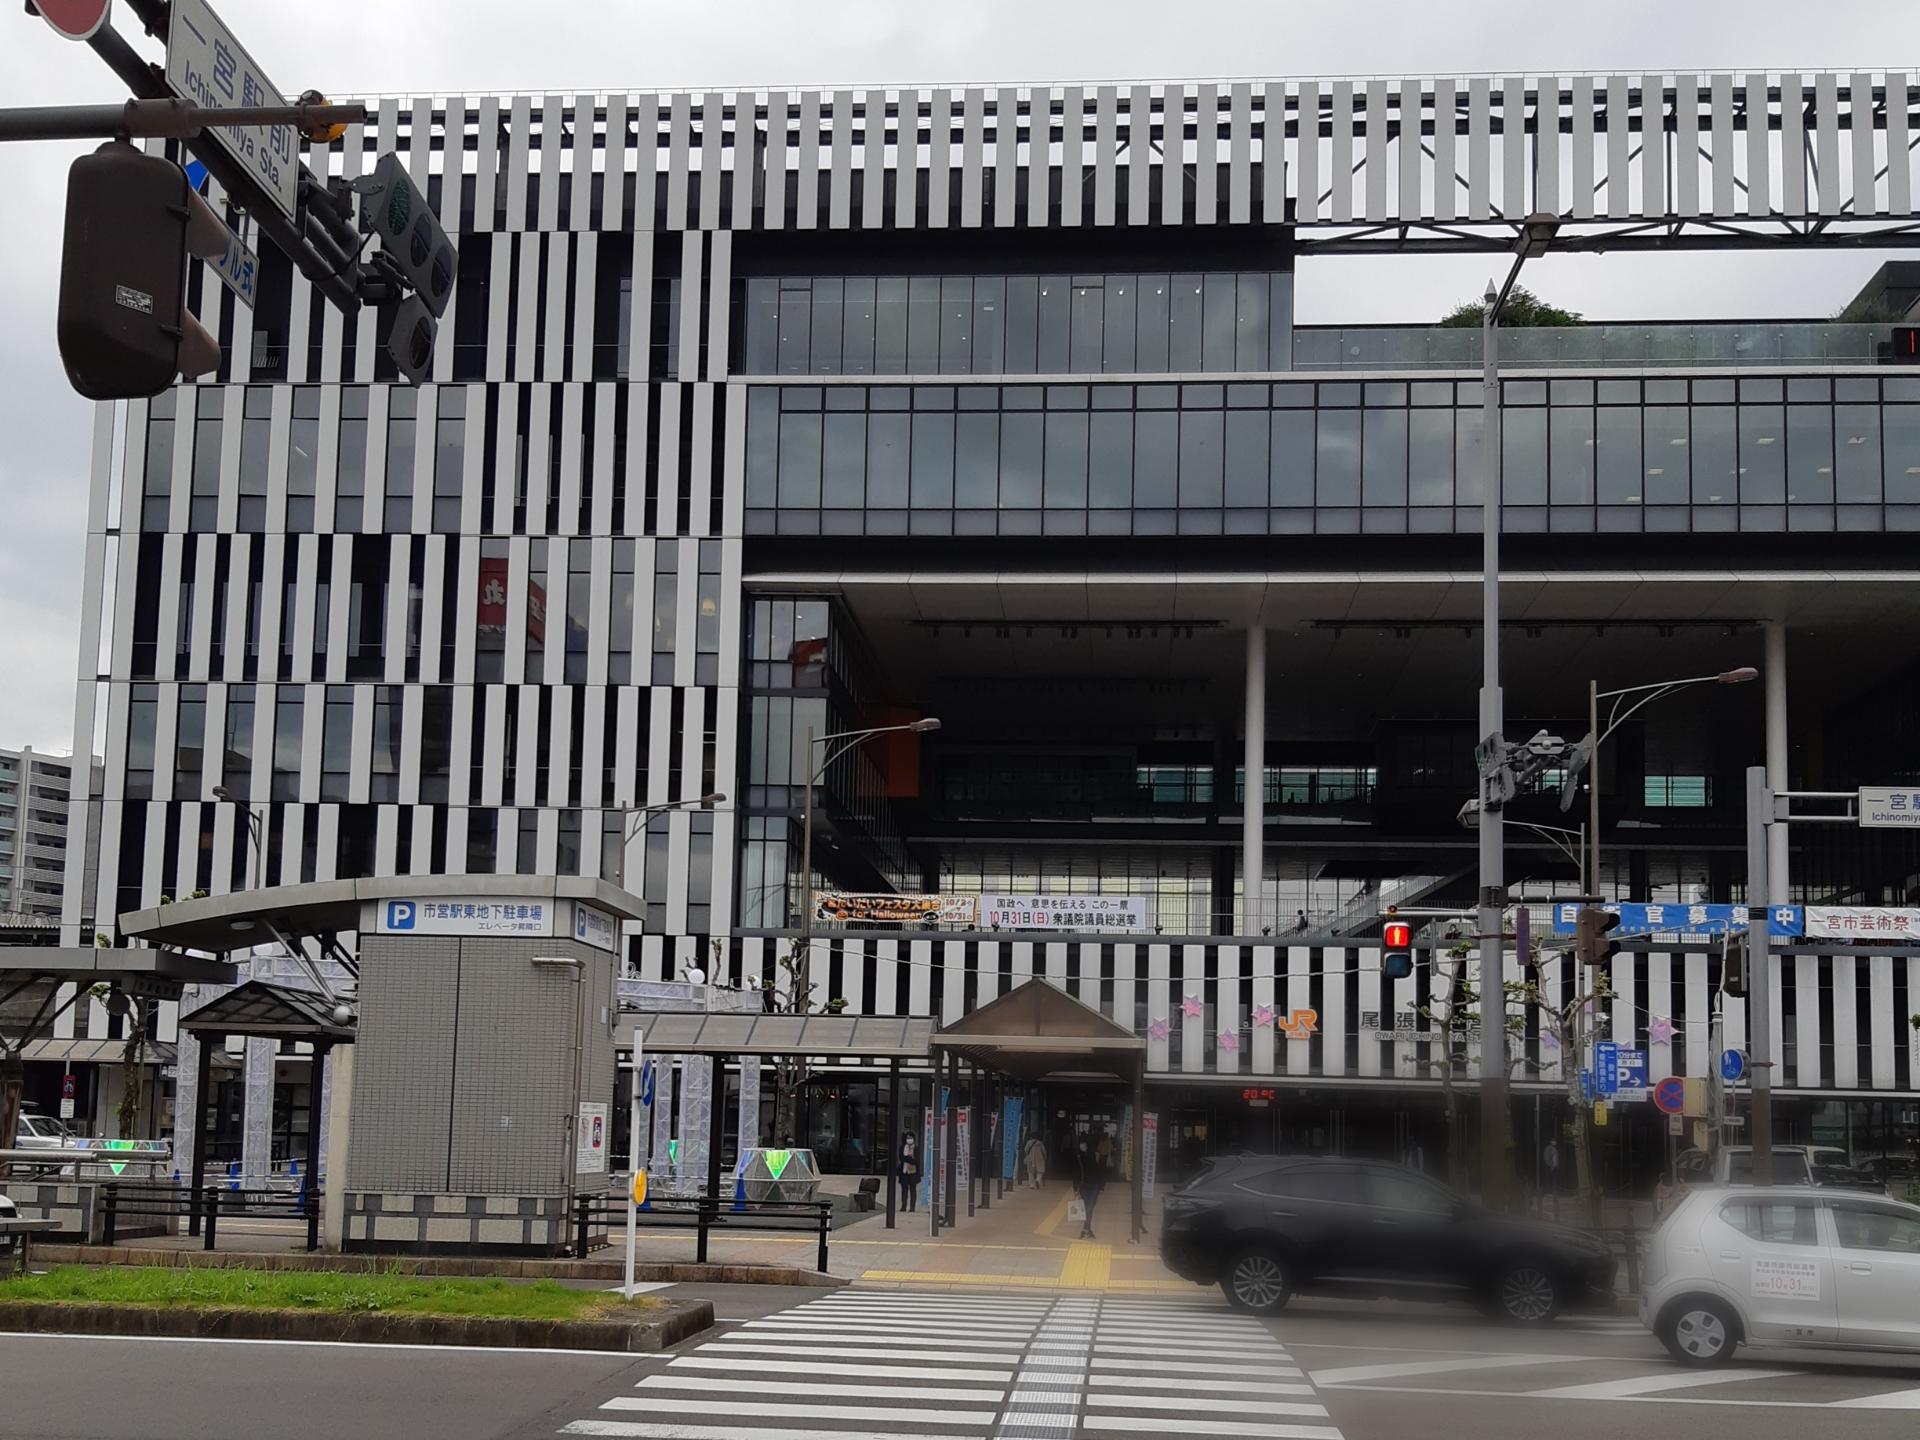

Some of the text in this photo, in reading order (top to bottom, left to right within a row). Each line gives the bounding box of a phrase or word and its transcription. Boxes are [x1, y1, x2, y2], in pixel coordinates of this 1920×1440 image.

[260, 147, 282, 193] Sta.
[423, 903, 543, 921] 市営駅東地下駐車場
[996, 899, 1128, 910] 国政へ 意思を伝える この一票
[393, 904, 411, 926] P
[852, 910, 922, 920] for Halloween
[1053, 912, 1136, 926] 衆議院議員総選挙
[1811, 914, 1909, 931] 一宮市芸術祭
[1279, 1009, 1318, 1031] JR
[1375, 1031, 1465, 1042] OWARI-ICHINOYA
